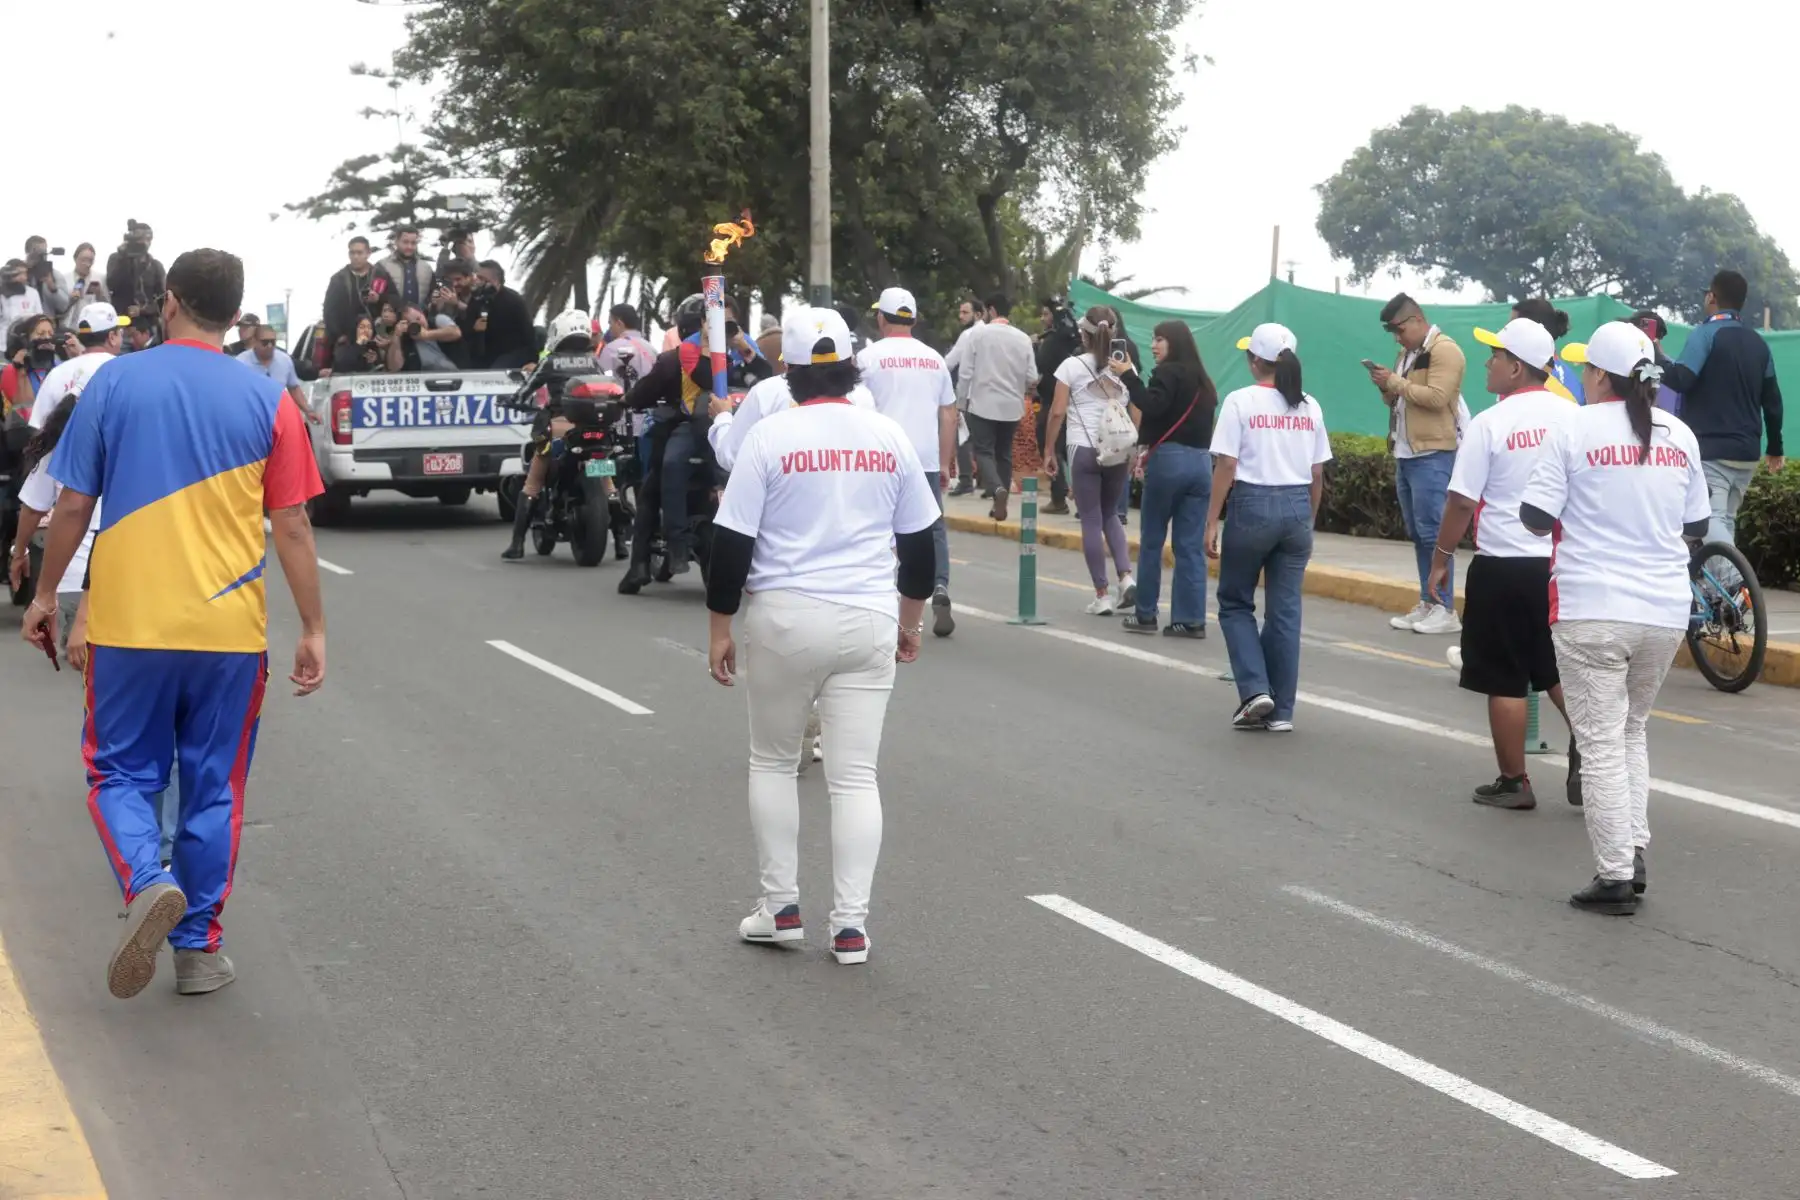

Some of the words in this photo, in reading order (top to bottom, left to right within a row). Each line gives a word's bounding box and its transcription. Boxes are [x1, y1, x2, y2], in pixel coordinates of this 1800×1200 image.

[553, 356, 595, 370] POLICIA
[1506, 428, 1546, 450] VOLU
[781, 449, 897, 474] VOLUNTARIO
